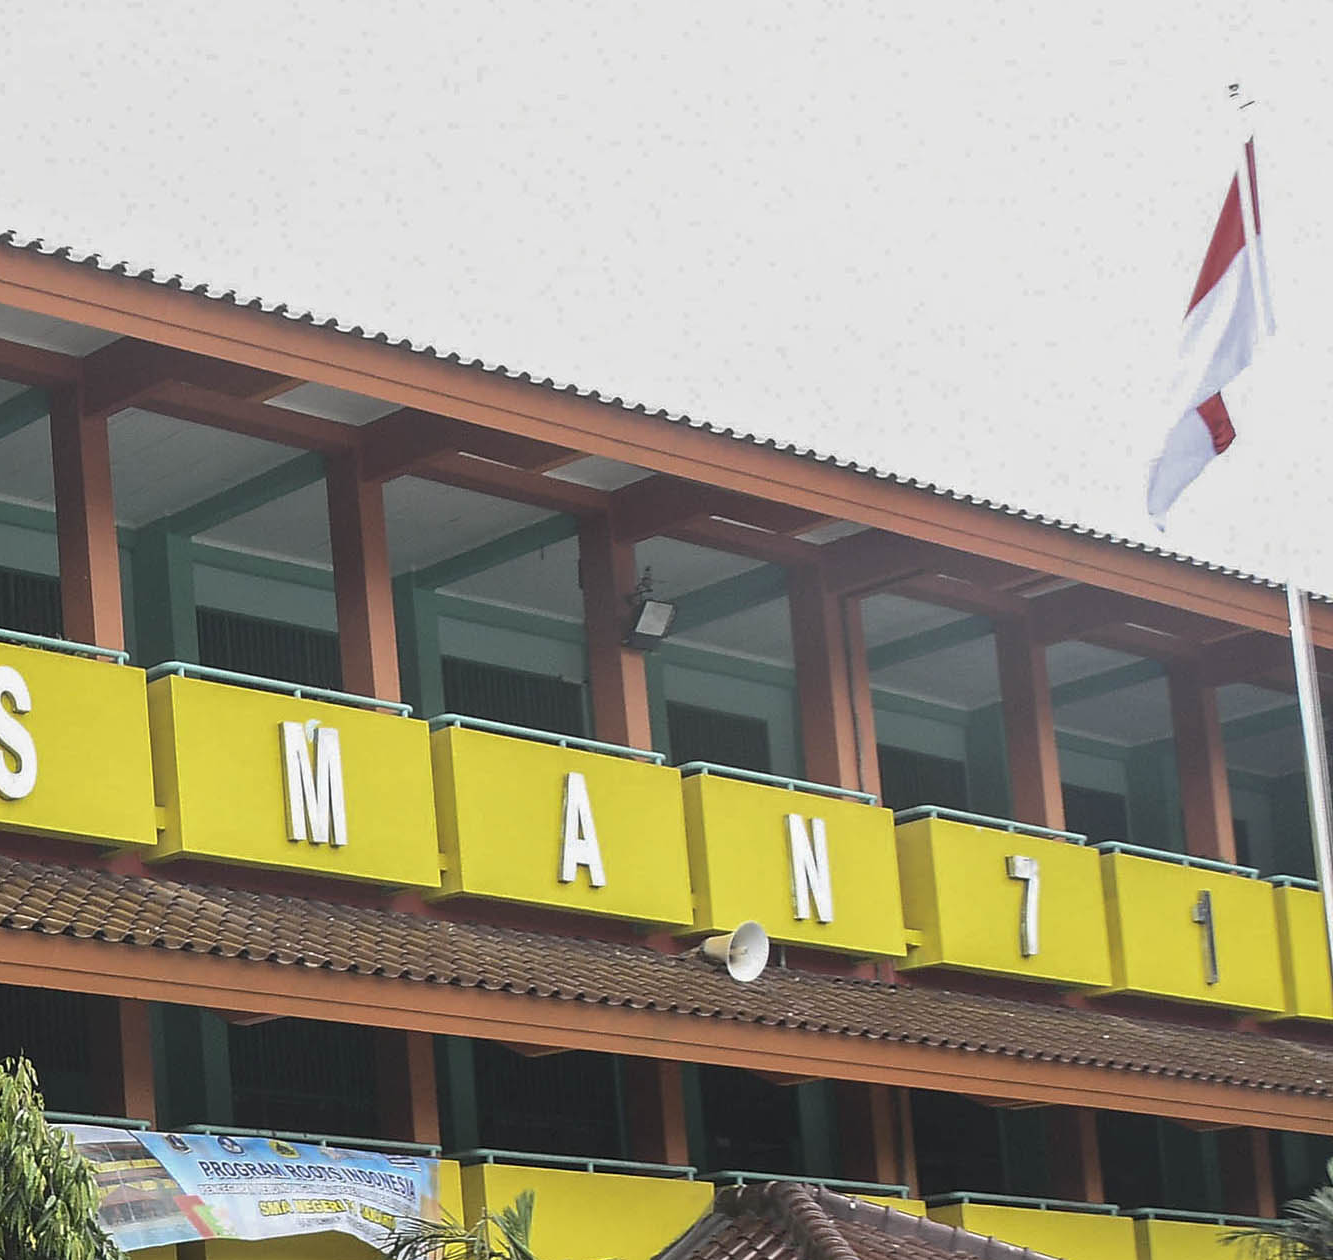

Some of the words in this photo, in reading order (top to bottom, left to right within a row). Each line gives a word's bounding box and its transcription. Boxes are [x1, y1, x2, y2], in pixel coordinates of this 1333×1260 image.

[198, 1160, 285, 1179] PROGRAM
[284, 1164, 342, 1181] ROOTS
[341, 1168, 417, 1198] INDONESIA
[259, 1200, 291, 1216] SMA
[293, 1199, 347, 1213] NEGERI
